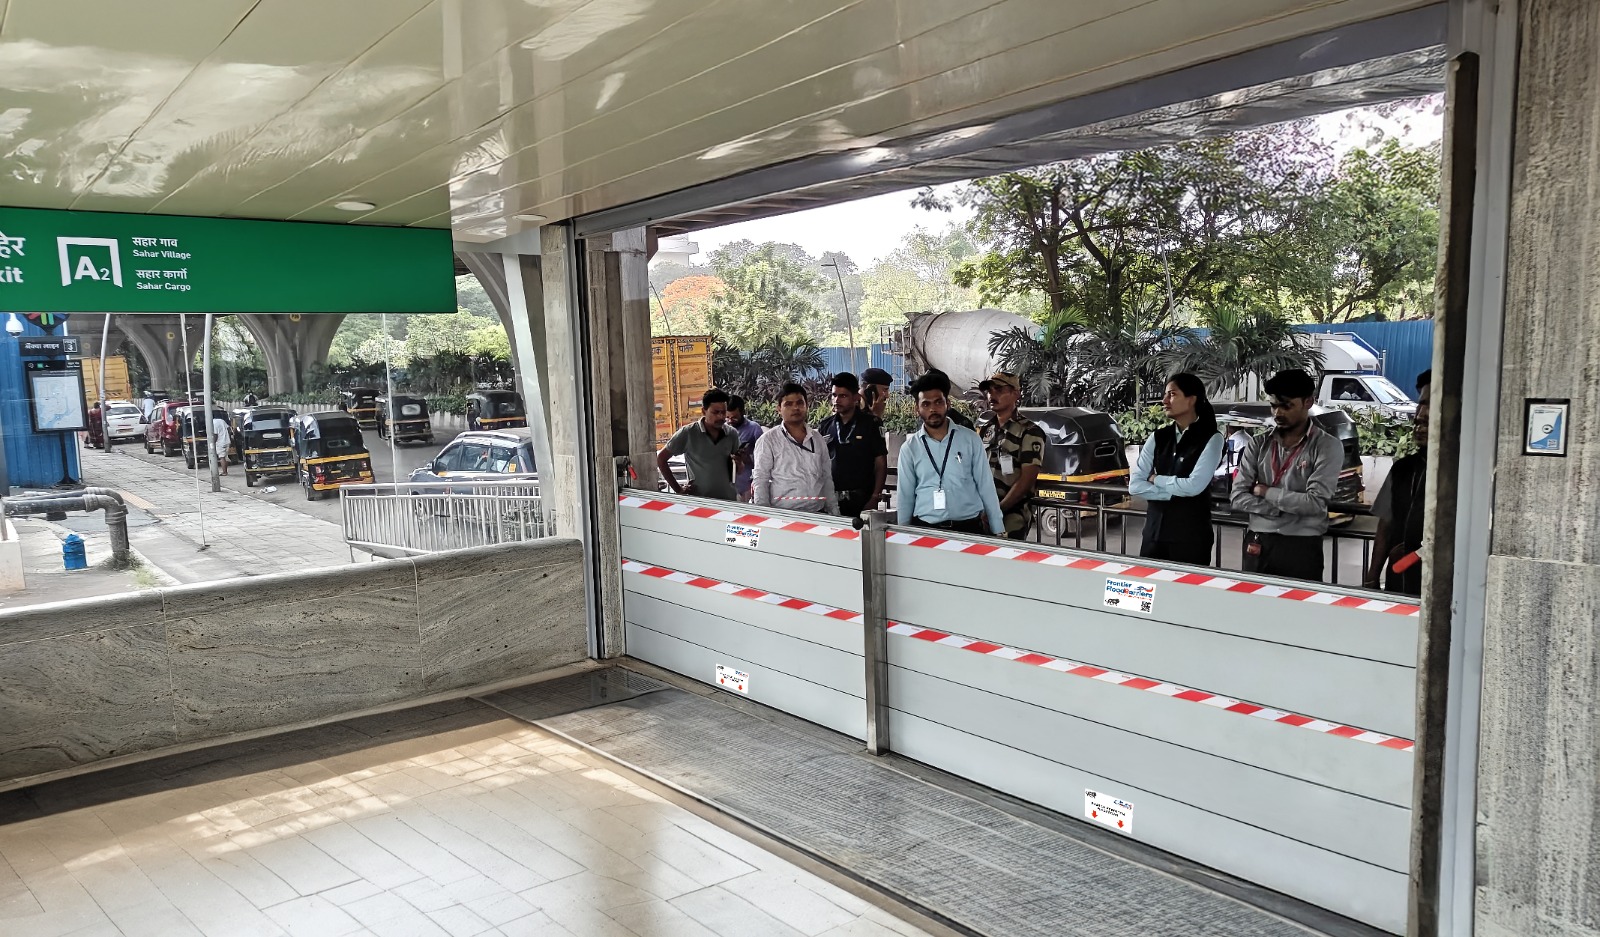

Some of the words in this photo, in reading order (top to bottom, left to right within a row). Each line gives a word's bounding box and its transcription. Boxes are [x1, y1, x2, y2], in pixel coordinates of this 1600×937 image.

[132, 237, 157, 247] सहार
[133, 249, 159, 258] Sahar
[161, 250, 191, 259] Village
[74, 256, 111, 281] A2
[136, 269, 161, 279] सहार
[163, 268, 188, 279] कार्गो
[136, 282, 162, 290] Sahar
[165, 282, 191, 292] Cargo
[1106, 580, 1132, 588] Frontier
